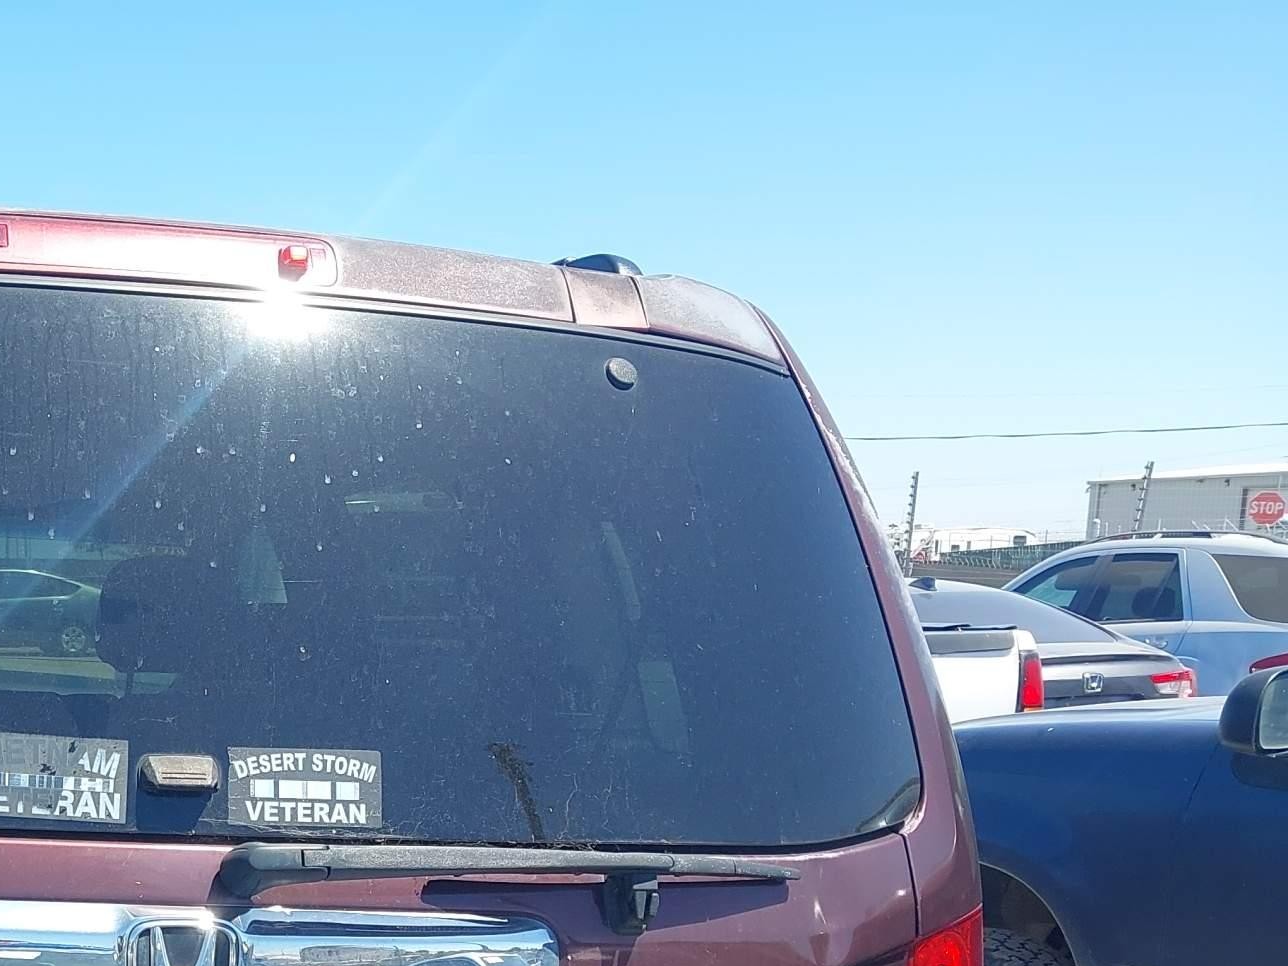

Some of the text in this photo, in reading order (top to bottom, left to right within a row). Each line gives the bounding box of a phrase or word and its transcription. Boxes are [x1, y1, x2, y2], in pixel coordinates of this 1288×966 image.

[1250, 501, 1284, 514] STOP
[232, 752, 377, 783] DESERT STORM
[245, 800, 367, 824] VETERAN
